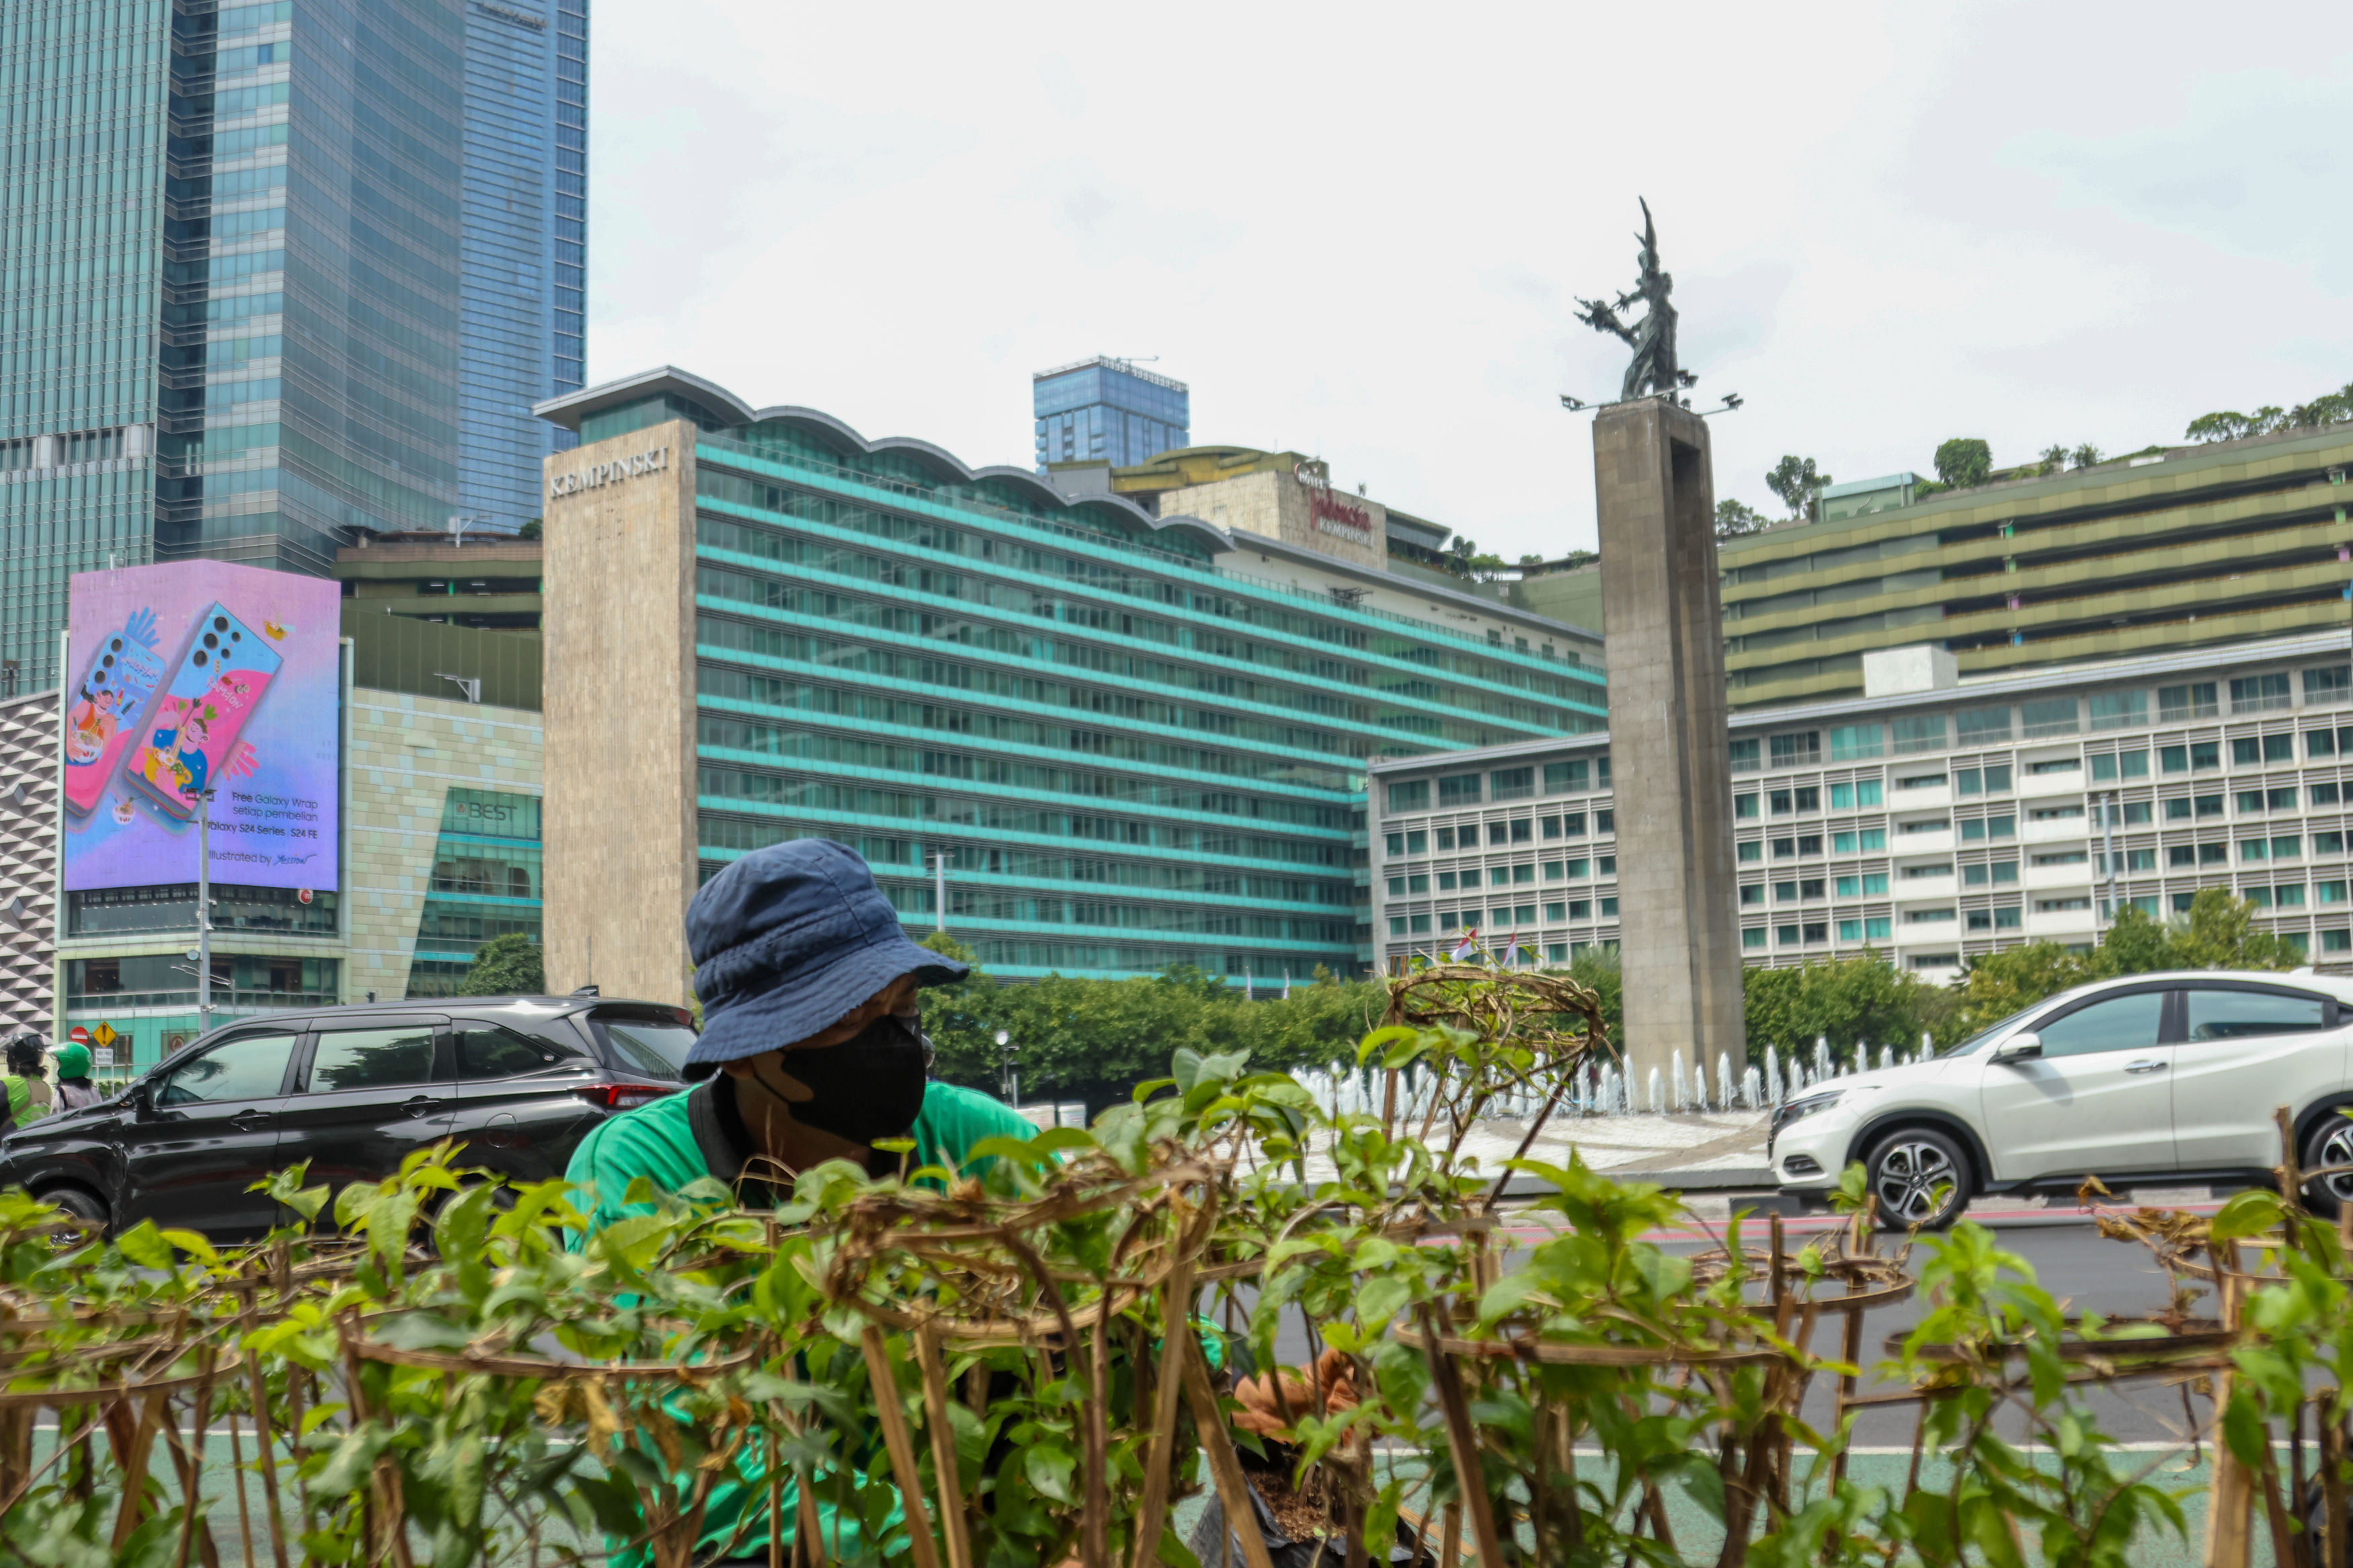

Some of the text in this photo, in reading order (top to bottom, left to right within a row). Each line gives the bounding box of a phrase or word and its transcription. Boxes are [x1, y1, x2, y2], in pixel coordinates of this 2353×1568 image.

[551, 447, 668, 499] KEMPINSKI
[1320, 515, 1374, 547] KEMPINSKI
[232, 791, 319, 811] Free Galaxy Wrap
[233, 806, 318, 822] setiap pembelian
[469, 802, 518, 822] BEST
[239, 823, 255, 833] S24
[257, 825, 286, 837] Series
[291, 827, 307, 837] S24
[308, 829, 318, 839] FE
[209, 850, 257, 863] Illustrated
[260, 854, 272, 866] by
